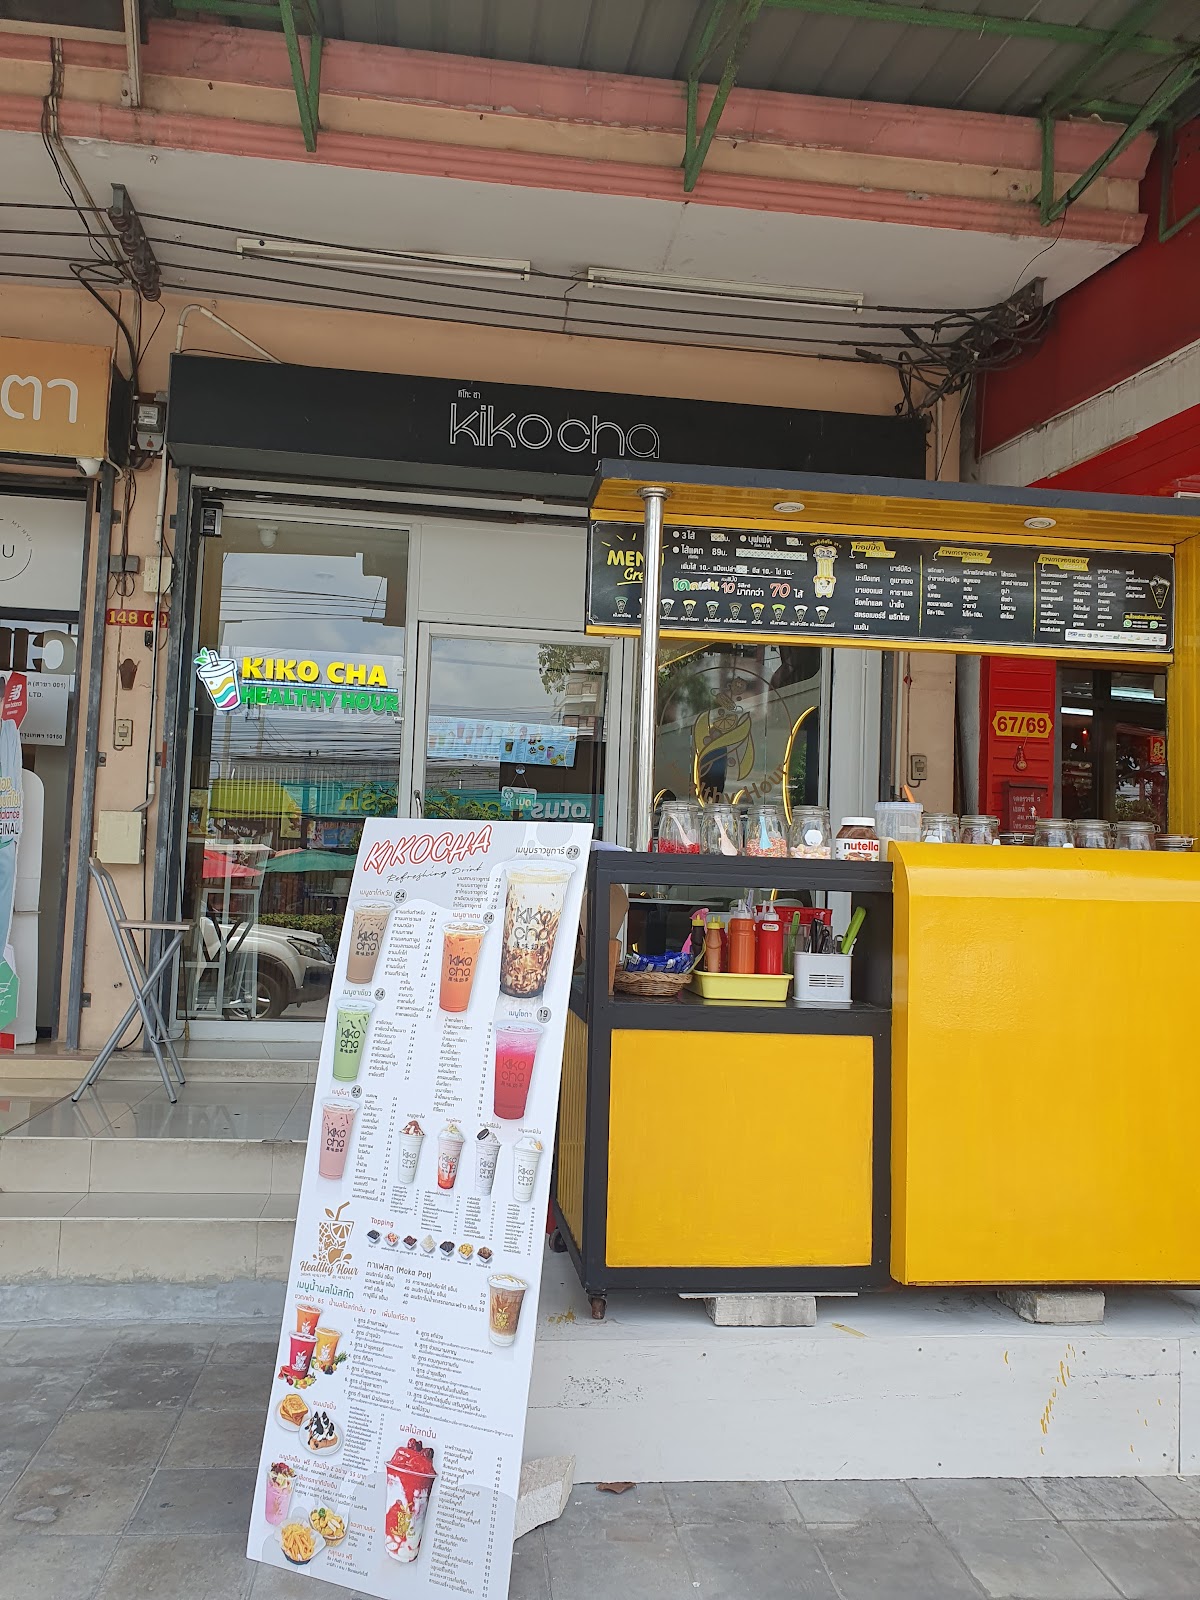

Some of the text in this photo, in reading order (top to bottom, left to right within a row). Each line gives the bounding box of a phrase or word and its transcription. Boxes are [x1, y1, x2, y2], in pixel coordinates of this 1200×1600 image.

[450, 403, 660, 458] kiko cha
[607, 550, 664, 566] MEN
[856, 574, 880, 582] มะเขือเทศ
[721, 583, 735, 594] 10
[737, 588, 764, 597] มากกว่า
[770, 582, 791, 598] 70
[109, 610, 138, 624] 148
[889, 612, 910, 621] พริกไทย
[242, 657, 388, 687] KIKO CHA
[242, 686, 400, 713] HEALTHY HOUR
[997, 716, 1048, 734] 67/69
[363, 824, 492, 874] KIKOCHA
[843, 840, 878, 850] nutella
[387, 862, 484, 883] Refreshing Drink
[358, 930, 378, 941] kiko
[357, 942, 376, 951] cha
[449, 954, 472, 966] kiko
[449, 967, 470, 977] cha
[539, 1009, 548, 1017] 19
[341, 1028, 360, 1039] kiko
[340, 1039, 359, 1048] cha
[327, 1127, 346, 1137] kiko
[327, 1138, 344, 1147] cha
[371, 1217, 394, 1228] Topping
[300, 1260, 358, 1276] Healthy Hour
[366, 1260, 432, 1279] กาแฟสด (Moka Pot)
